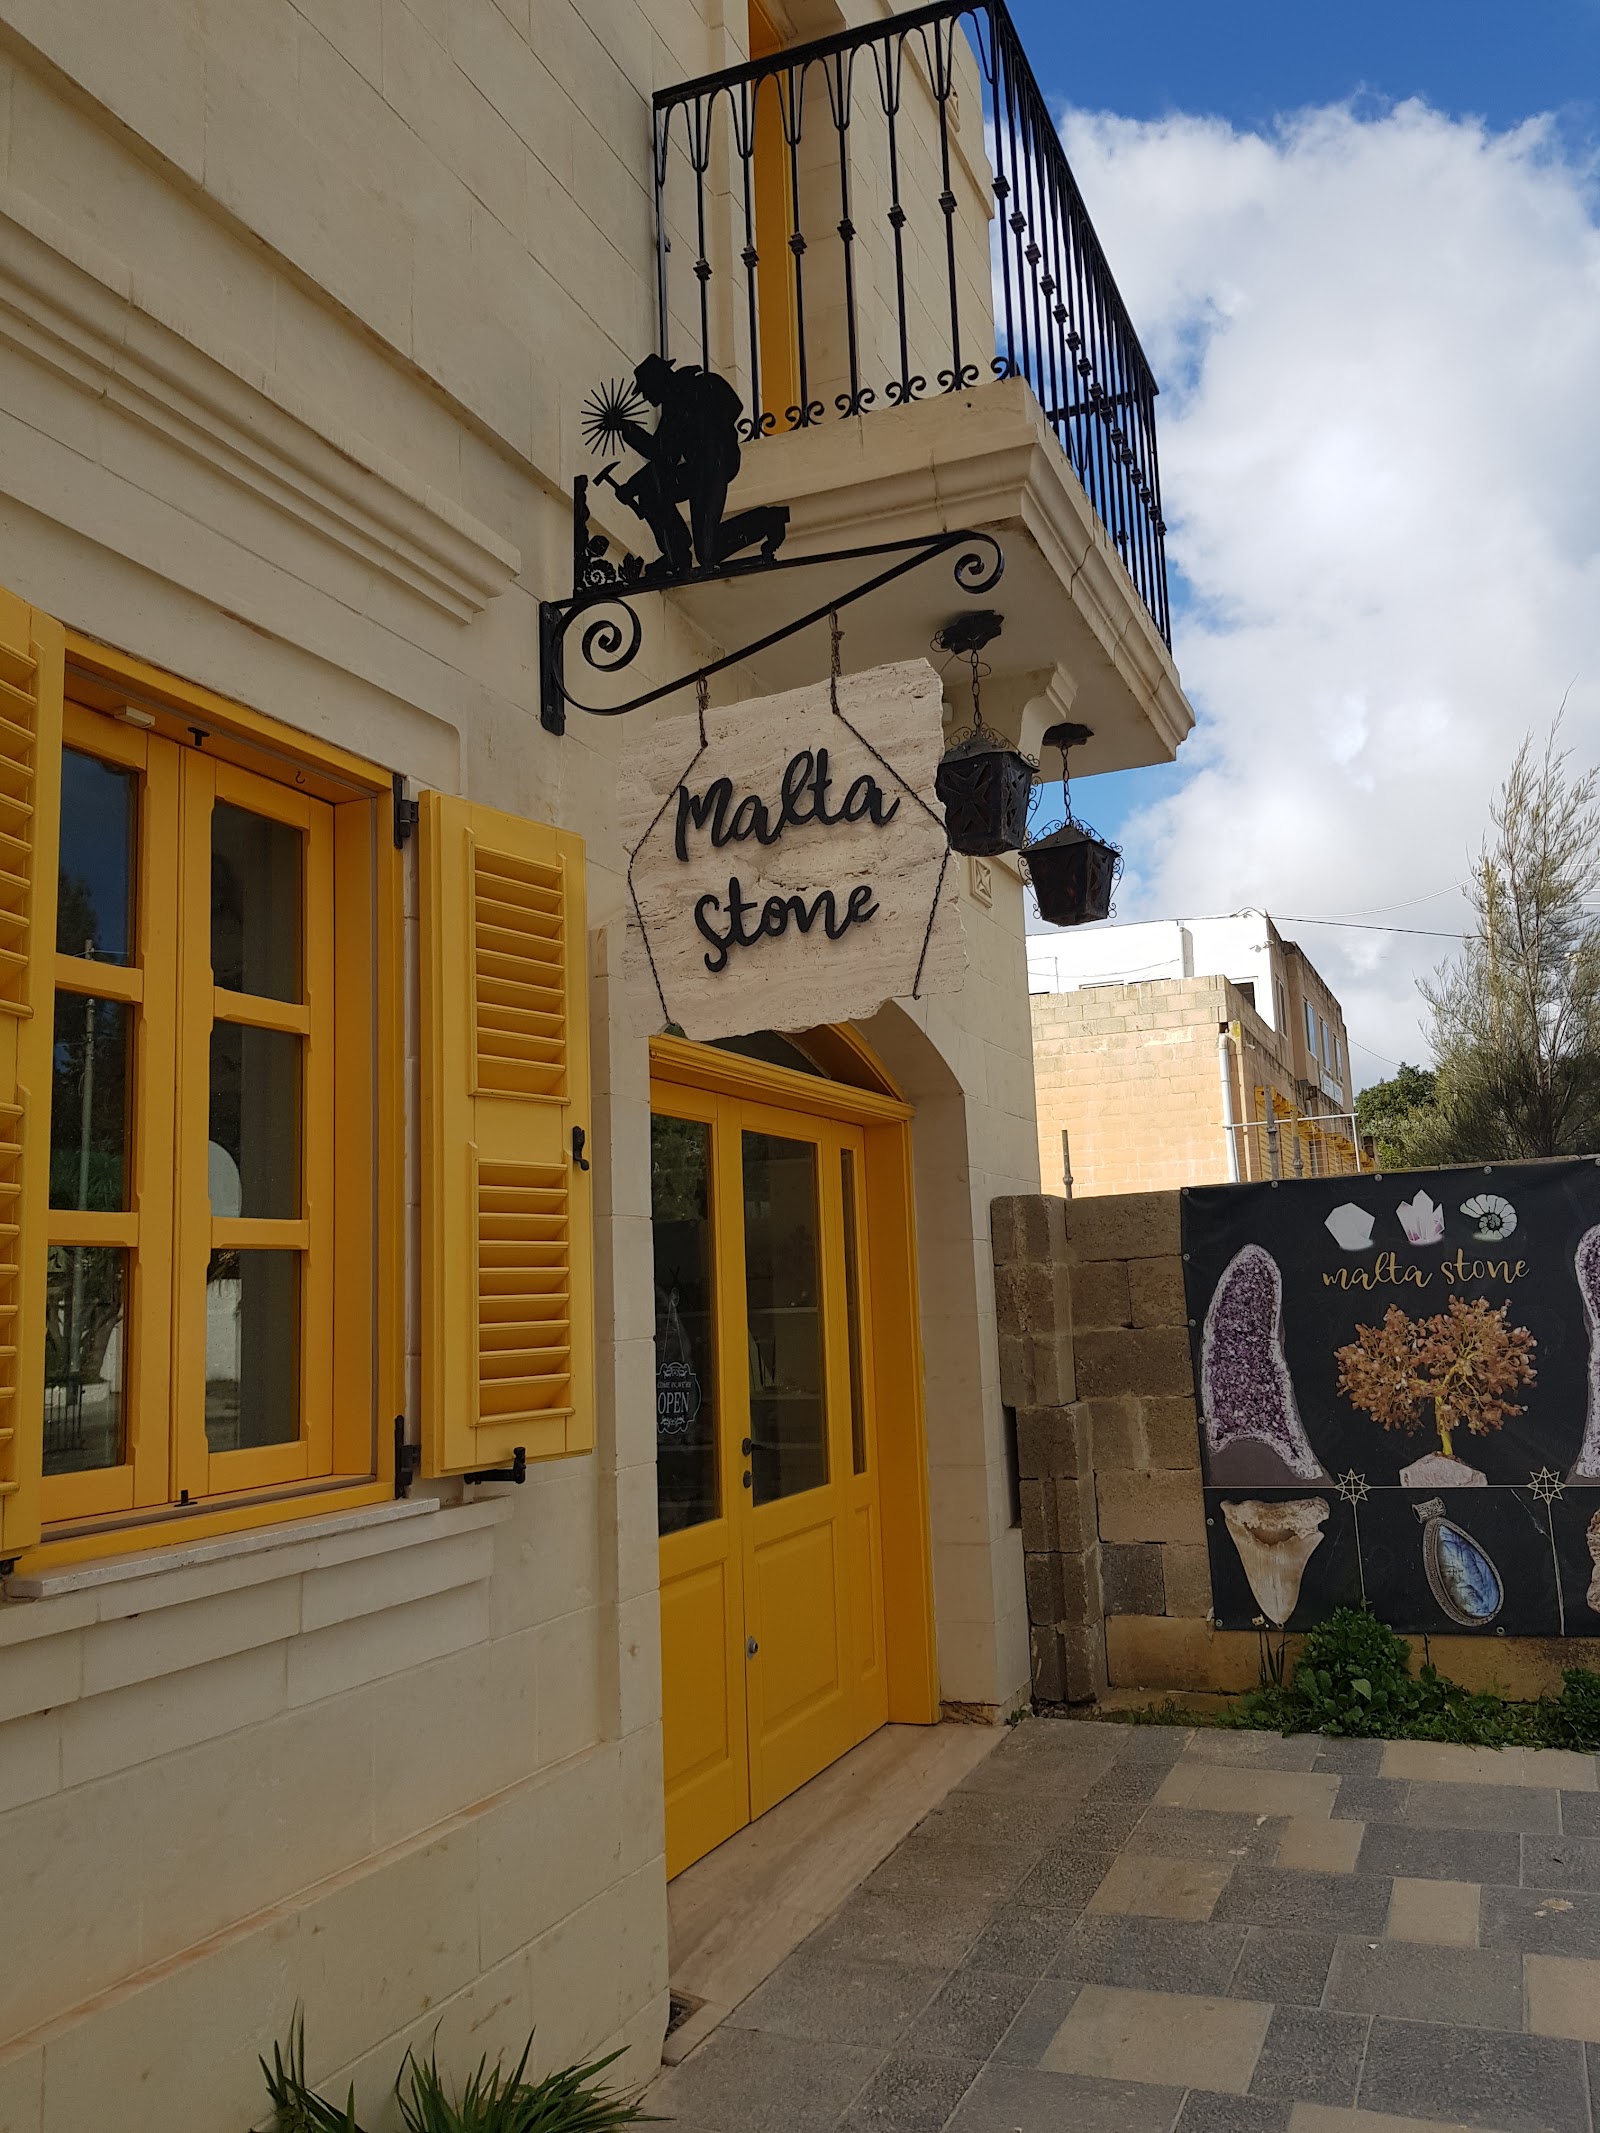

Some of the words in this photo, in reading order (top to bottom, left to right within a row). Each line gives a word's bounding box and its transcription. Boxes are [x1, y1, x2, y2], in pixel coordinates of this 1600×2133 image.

[675, 748, 900, 862] Malta
[1322, 1251, 1433, 1290] malta
[1440, 1247, 1530, 1284] stone
[657, 1392, 690, 1414] OPEN
